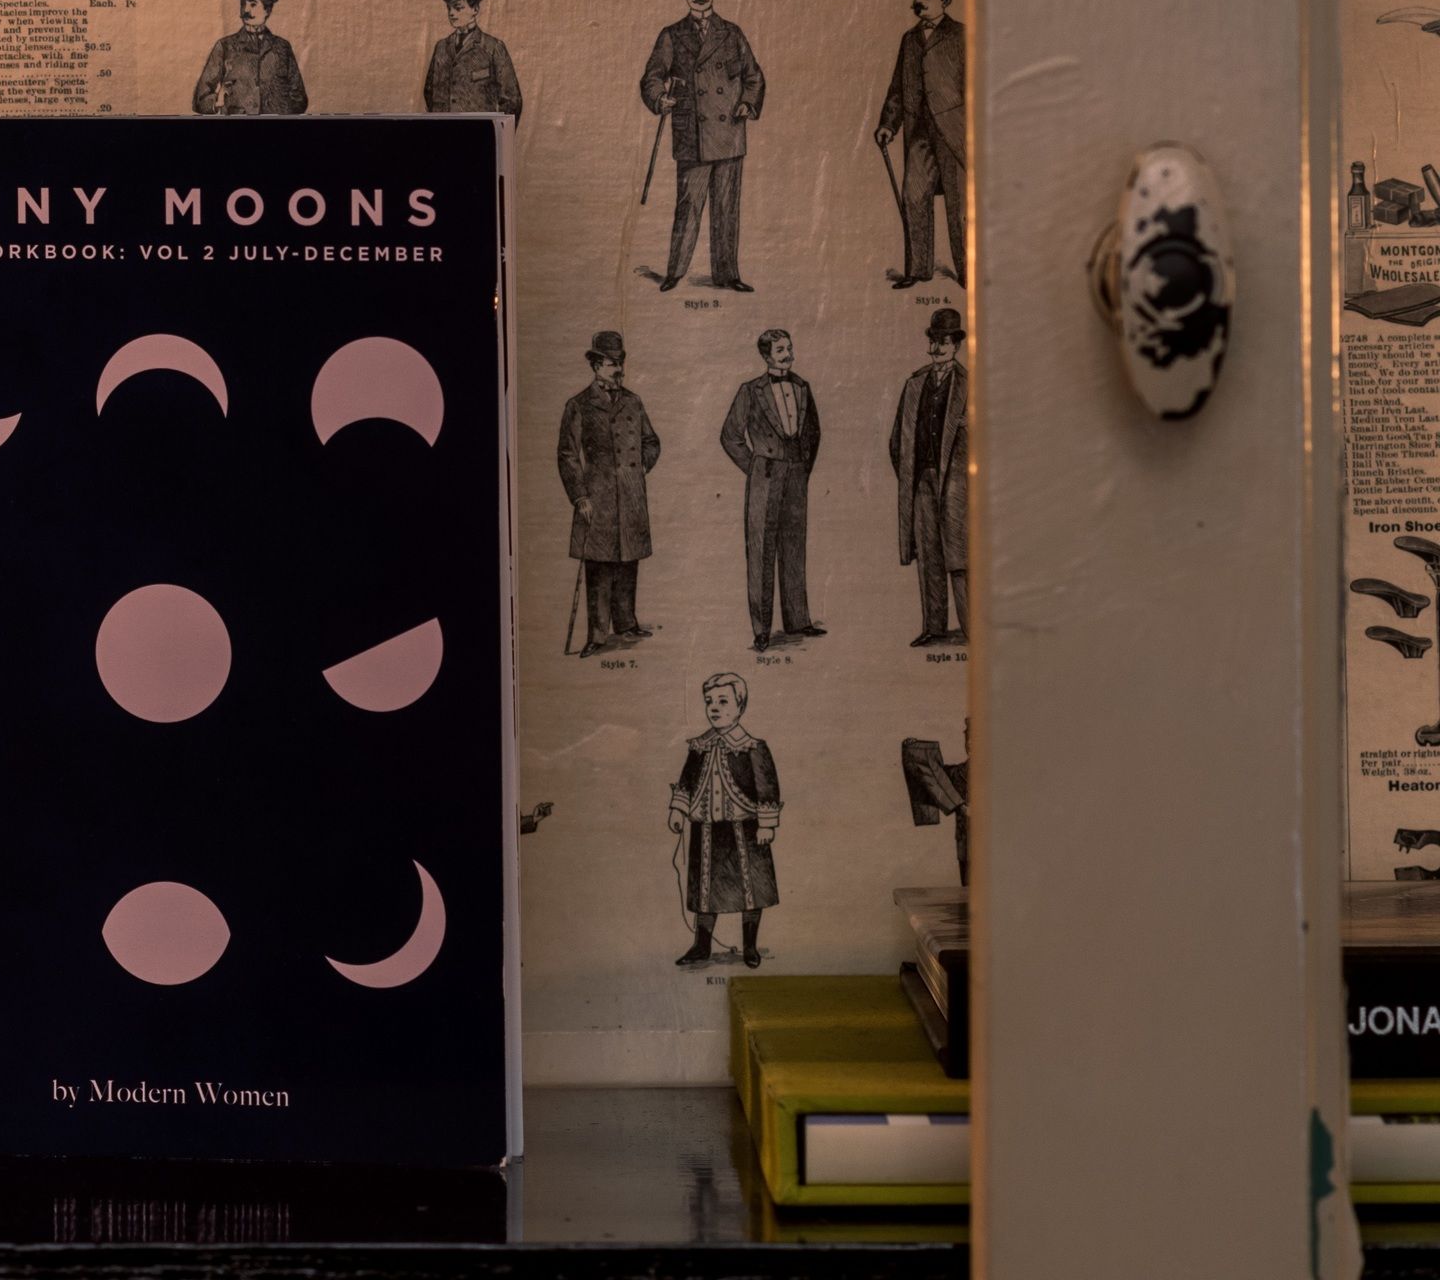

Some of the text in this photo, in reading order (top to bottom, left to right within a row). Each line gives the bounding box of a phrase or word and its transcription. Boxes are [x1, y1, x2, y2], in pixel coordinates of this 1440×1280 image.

[163, 186, 438, 228] MOONS
[139, 244, 191, 261] VOL
[202, 245, 216, 261] 2
[229, 244, 445, 264] JULY-DECEMBER
[51, 1077, 290, 1108] by Modern Women
